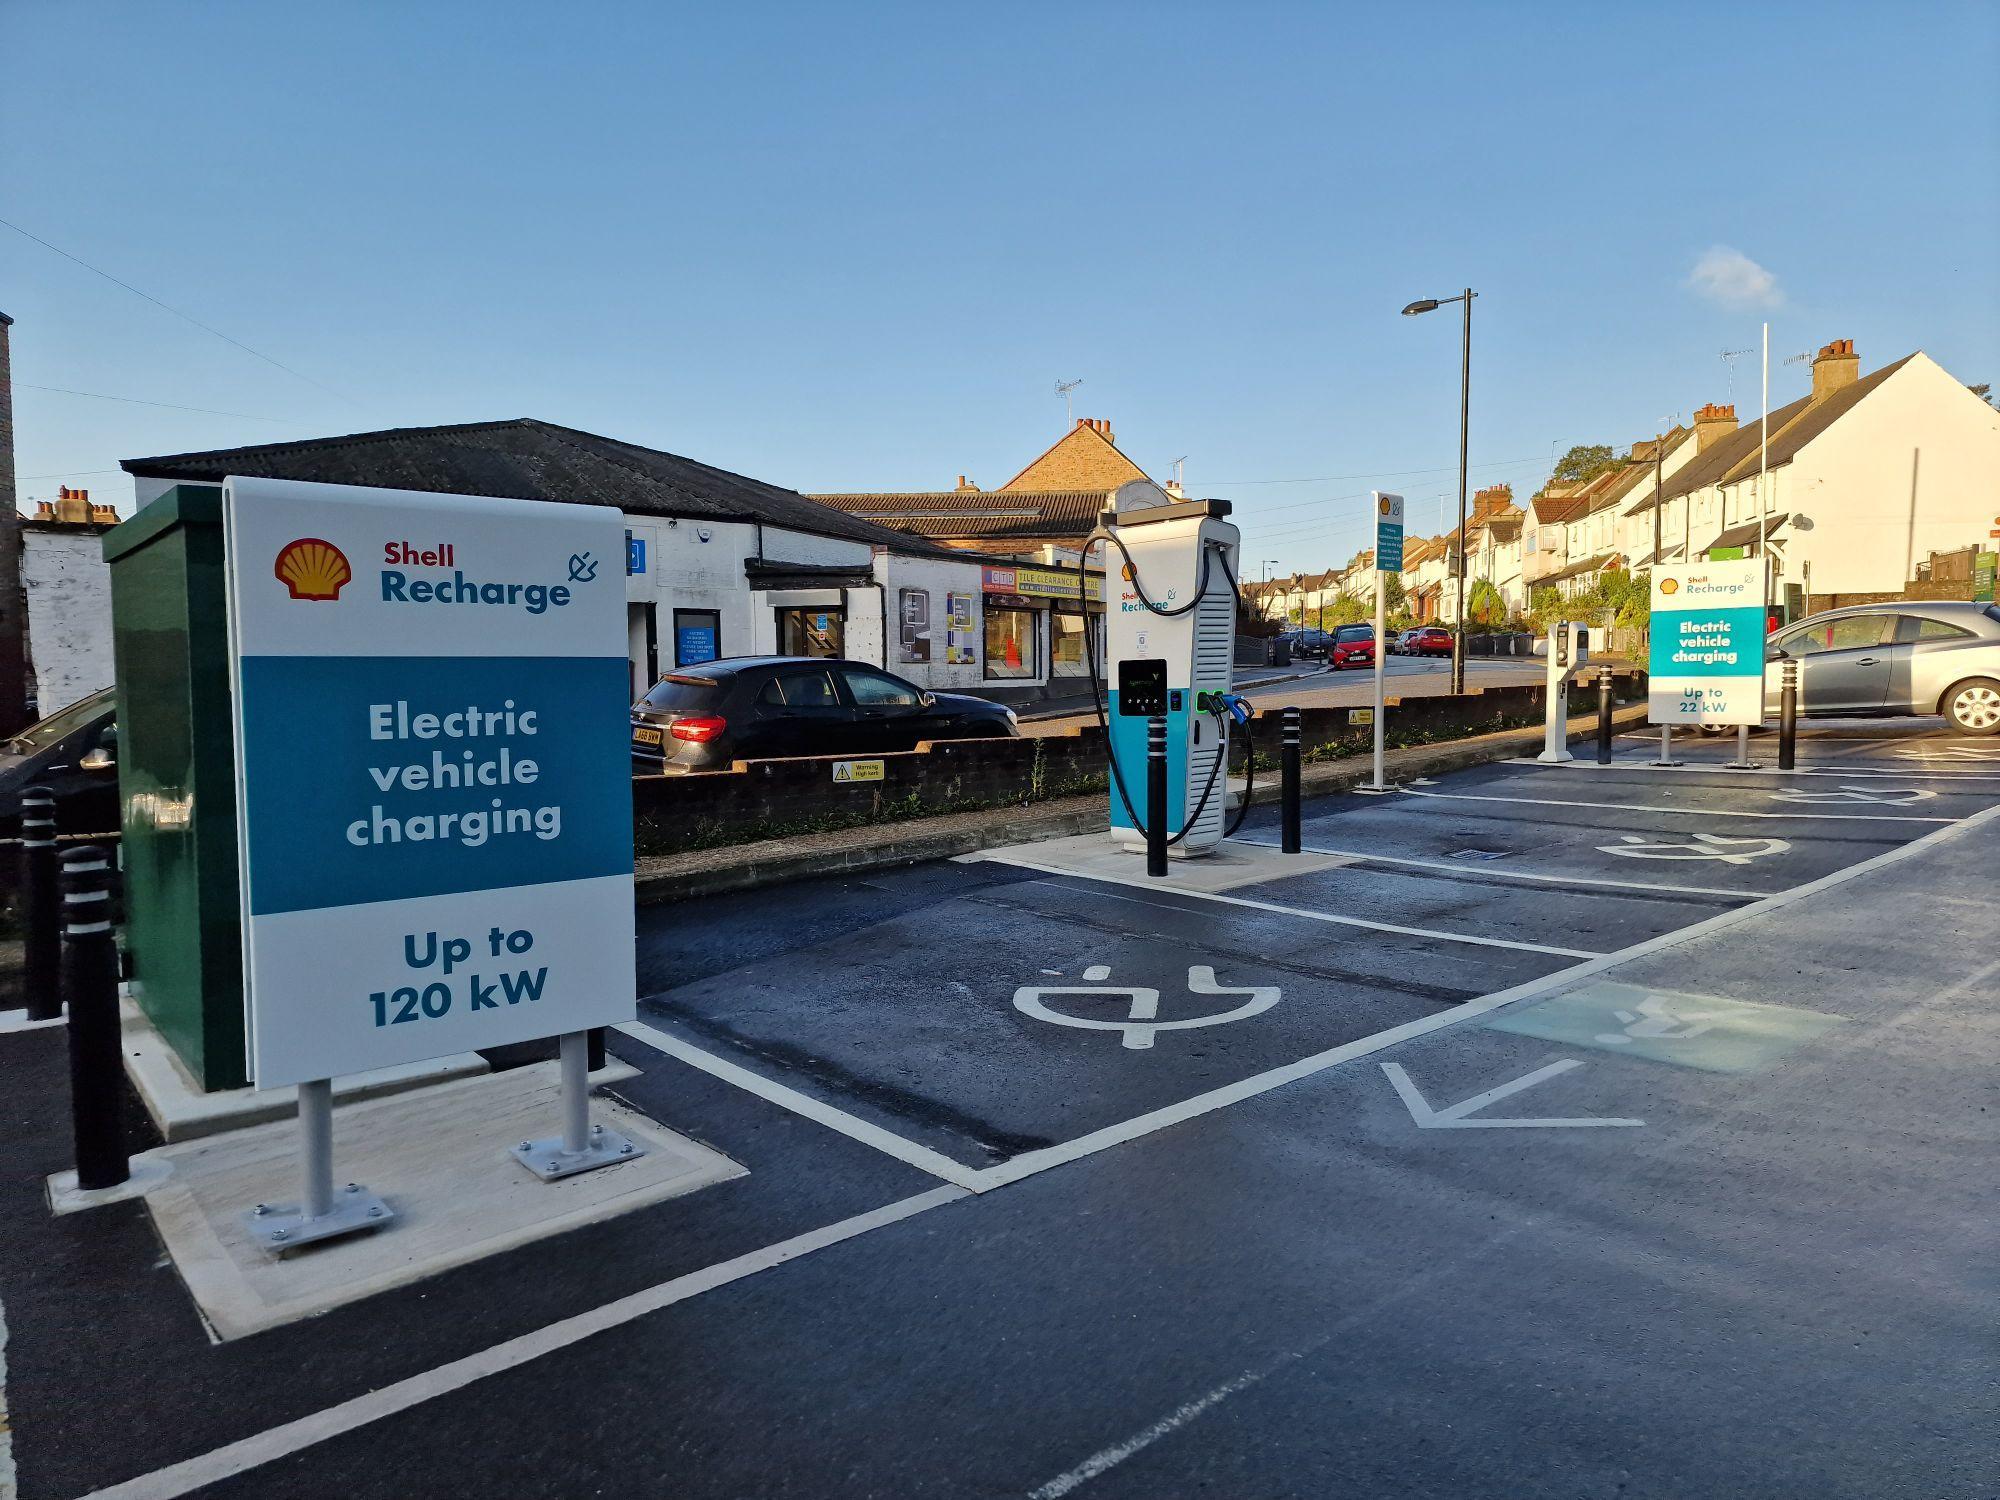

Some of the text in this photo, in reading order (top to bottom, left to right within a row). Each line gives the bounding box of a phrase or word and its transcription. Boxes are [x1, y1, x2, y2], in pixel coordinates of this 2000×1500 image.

[384, 541, 454, 567] Shell
[992, 571, 1014, 582] CTD
[1019, 572, 1098, 588] TILE CLEARANCE CTRE
[1688, 576, 1708, 584] Shell
[381, 570, 571, 614] Recharge
[1687, 583, 1745, 595] Recharge
[1680, 620, 1731, 634] Electric
[1679, 634, 1731, 648] vehicle
[1672, 650, 1738, 665] charging
[1684, 688, 1723, 700] Up to
[1680, 702, 1727, 713] 22 kW
[369, 699, 538, 740] Electric
[368, 748, 540, 792] vehicle
[346, 798, 561, 847] charging
[404, 927, 534, 974] Up to
[369, 967, 549, 1027] 120 kW
